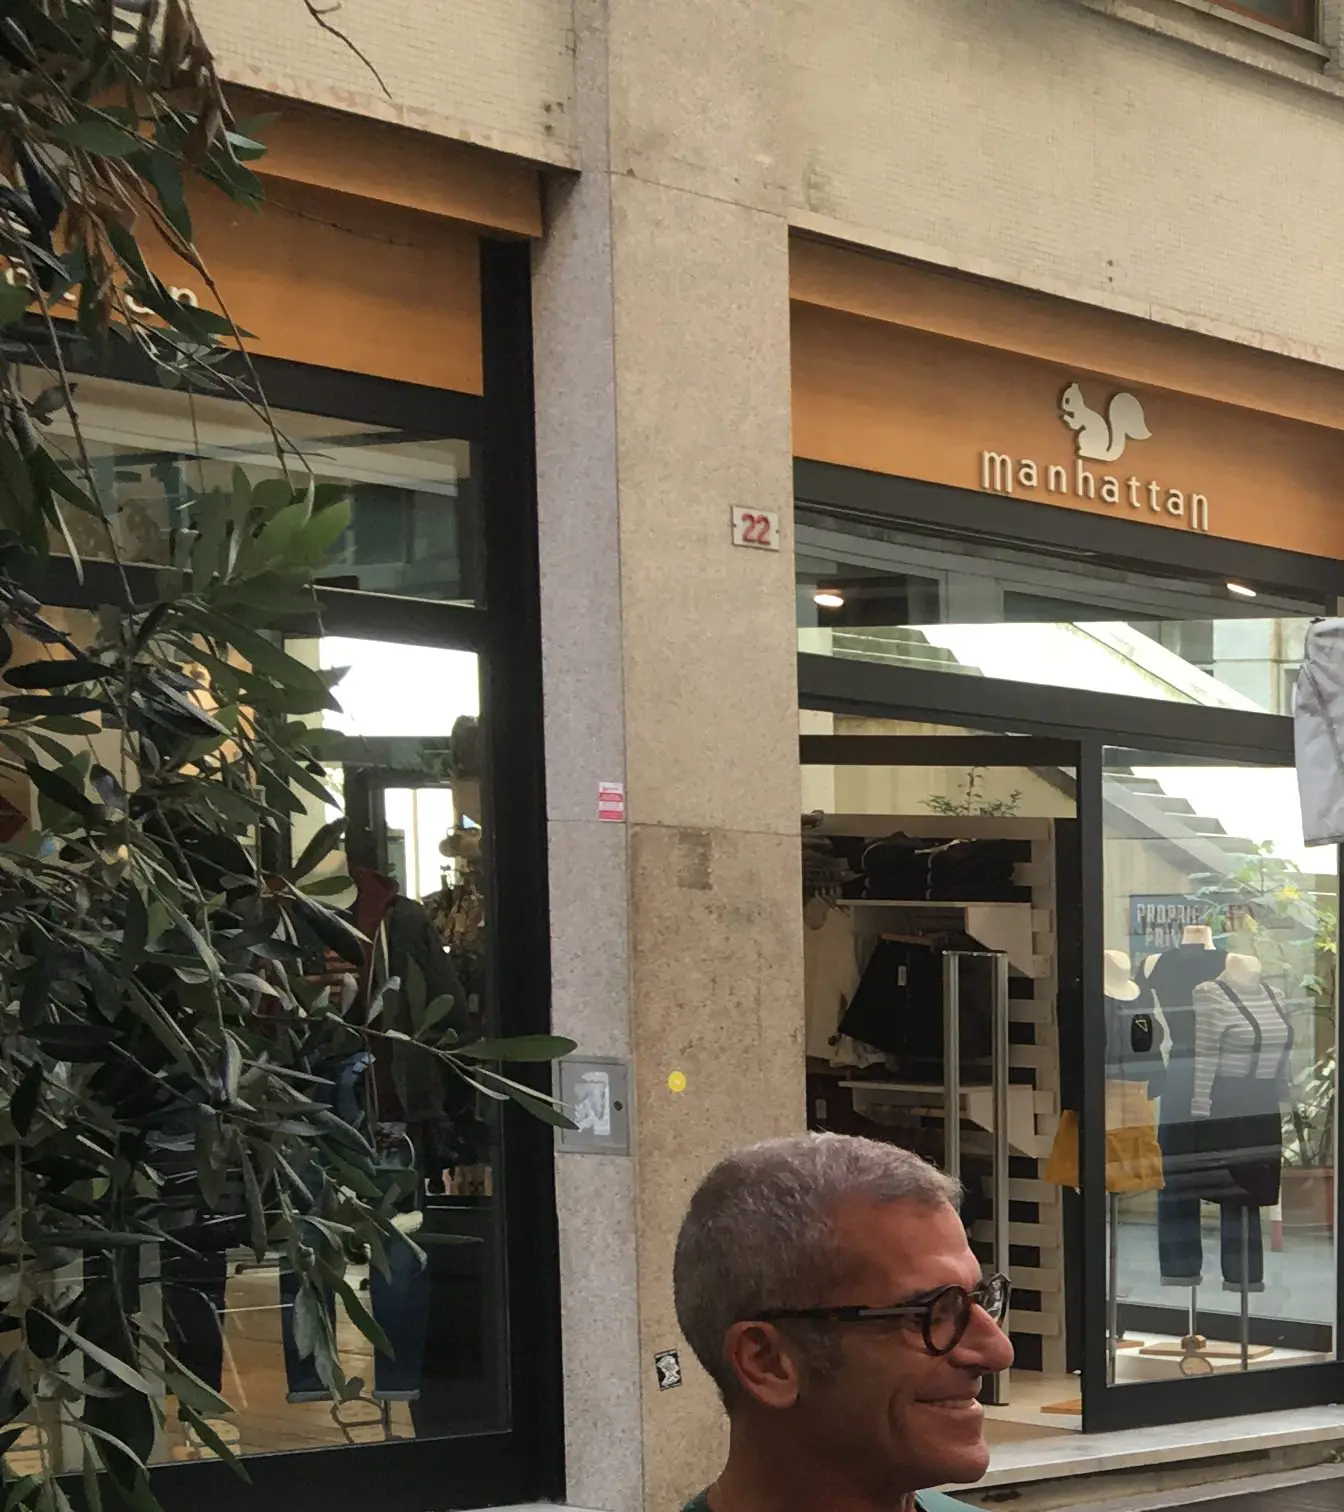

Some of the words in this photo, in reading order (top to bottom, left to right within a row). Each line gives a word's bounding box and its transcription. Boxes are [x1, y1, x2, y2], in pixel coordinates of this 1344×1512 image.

[981, 450, 1208, 531] manhattan
[741, 512, 771, 546] 22
[1145, 927, 1181, 949] PRIV
